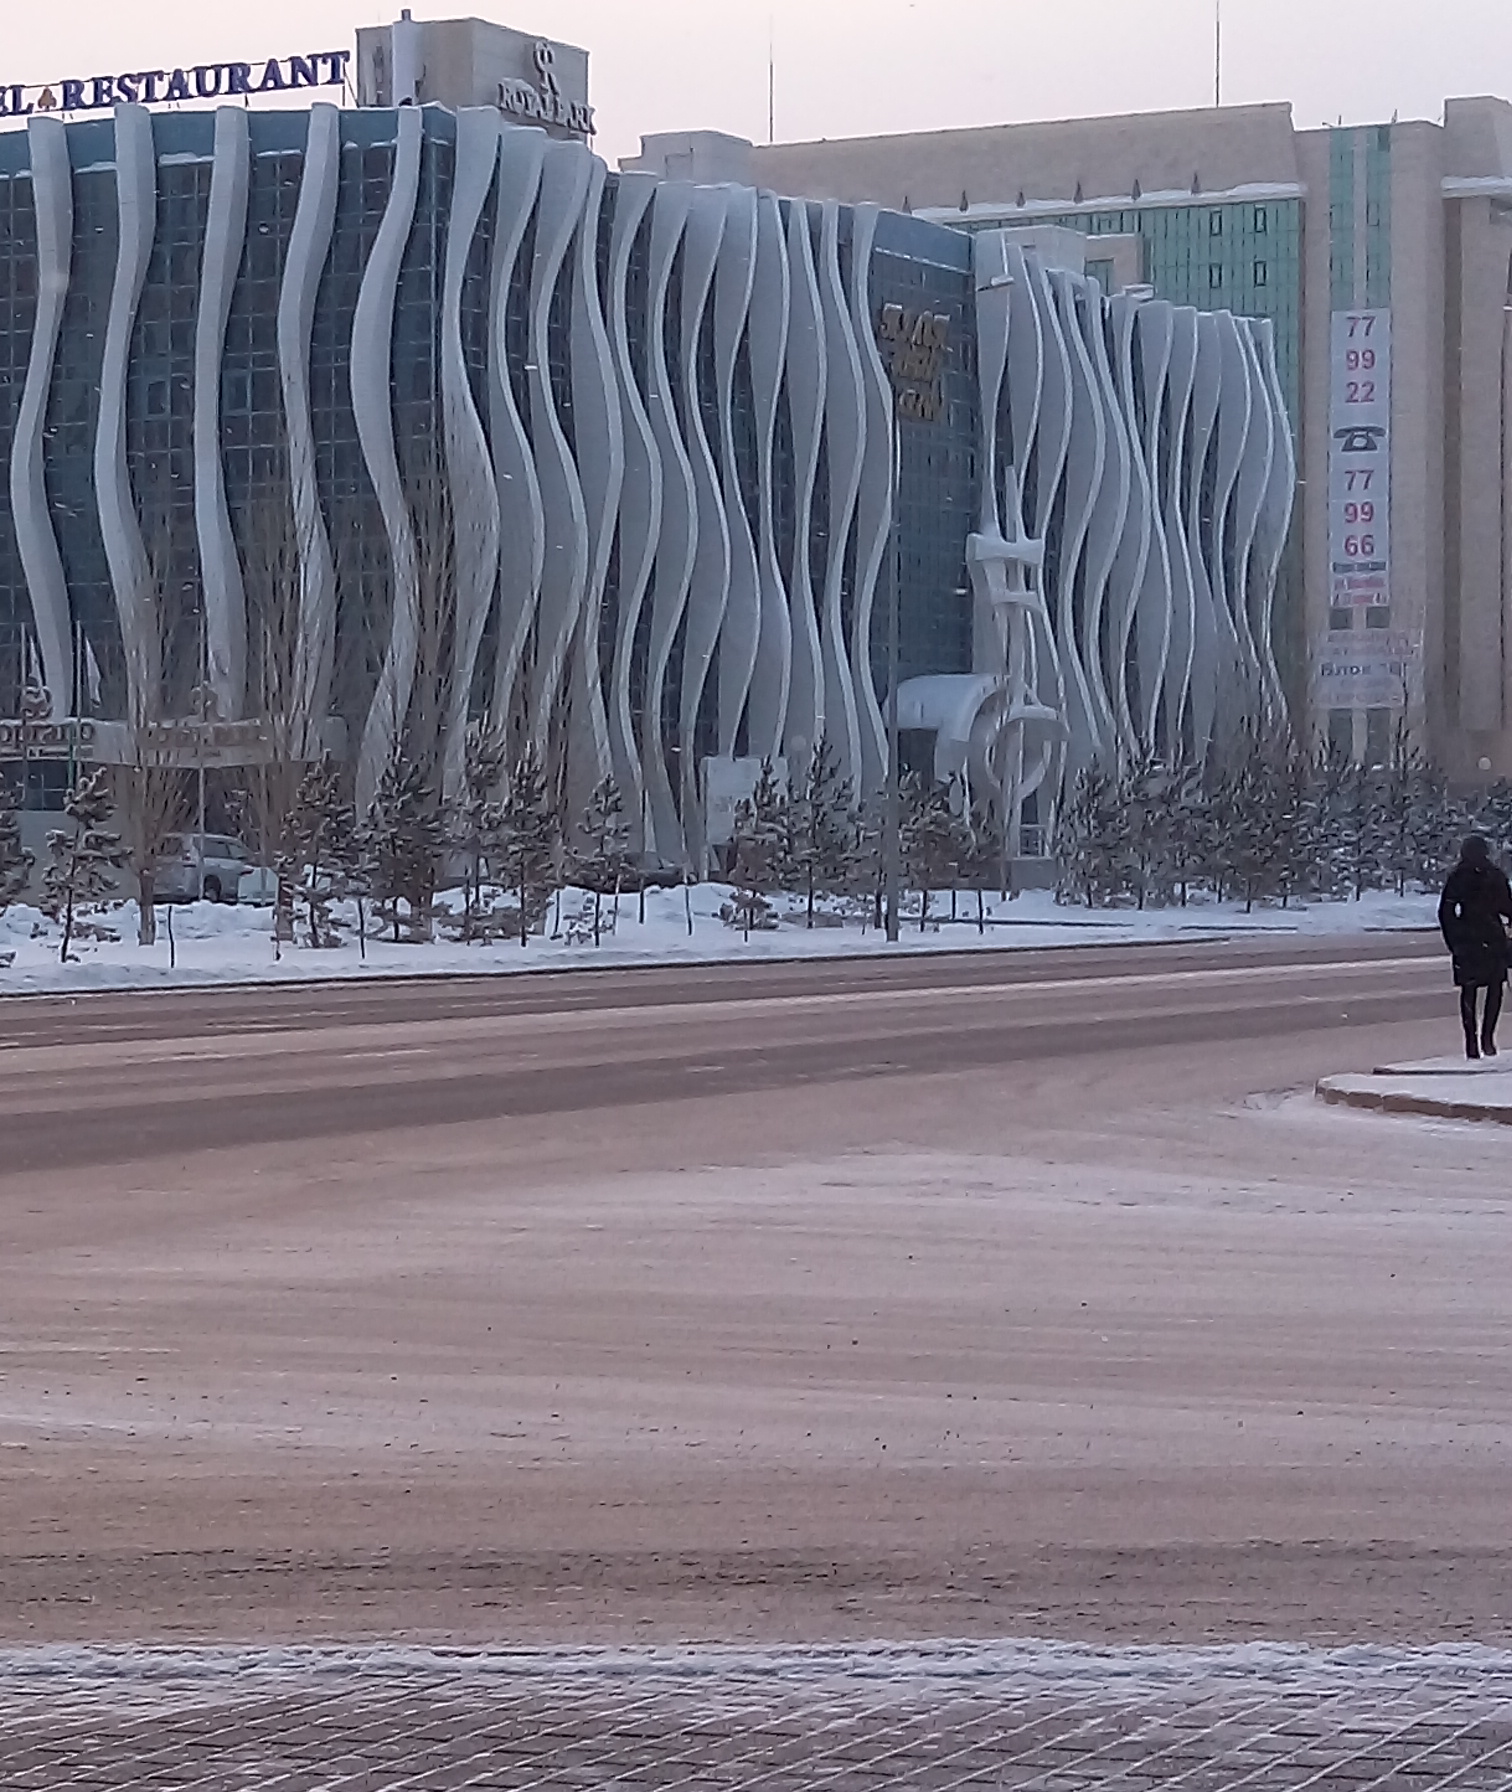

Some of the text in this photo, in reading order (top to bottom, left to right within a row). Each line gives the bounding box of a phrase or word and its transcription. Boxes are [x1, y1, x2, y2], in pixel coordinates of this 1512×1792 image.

[60, 50, 350, 110] RESTAURANT
[1346, 316, 1376, 337] 77
[1346, 349, 1376, 370] 99
[1345, 381, 1375, 403] 22
[1344, 470, 1375, 491] 77
[1344, 501, 1375, 523] 99
[1344, 534, 1375, 556] 66
